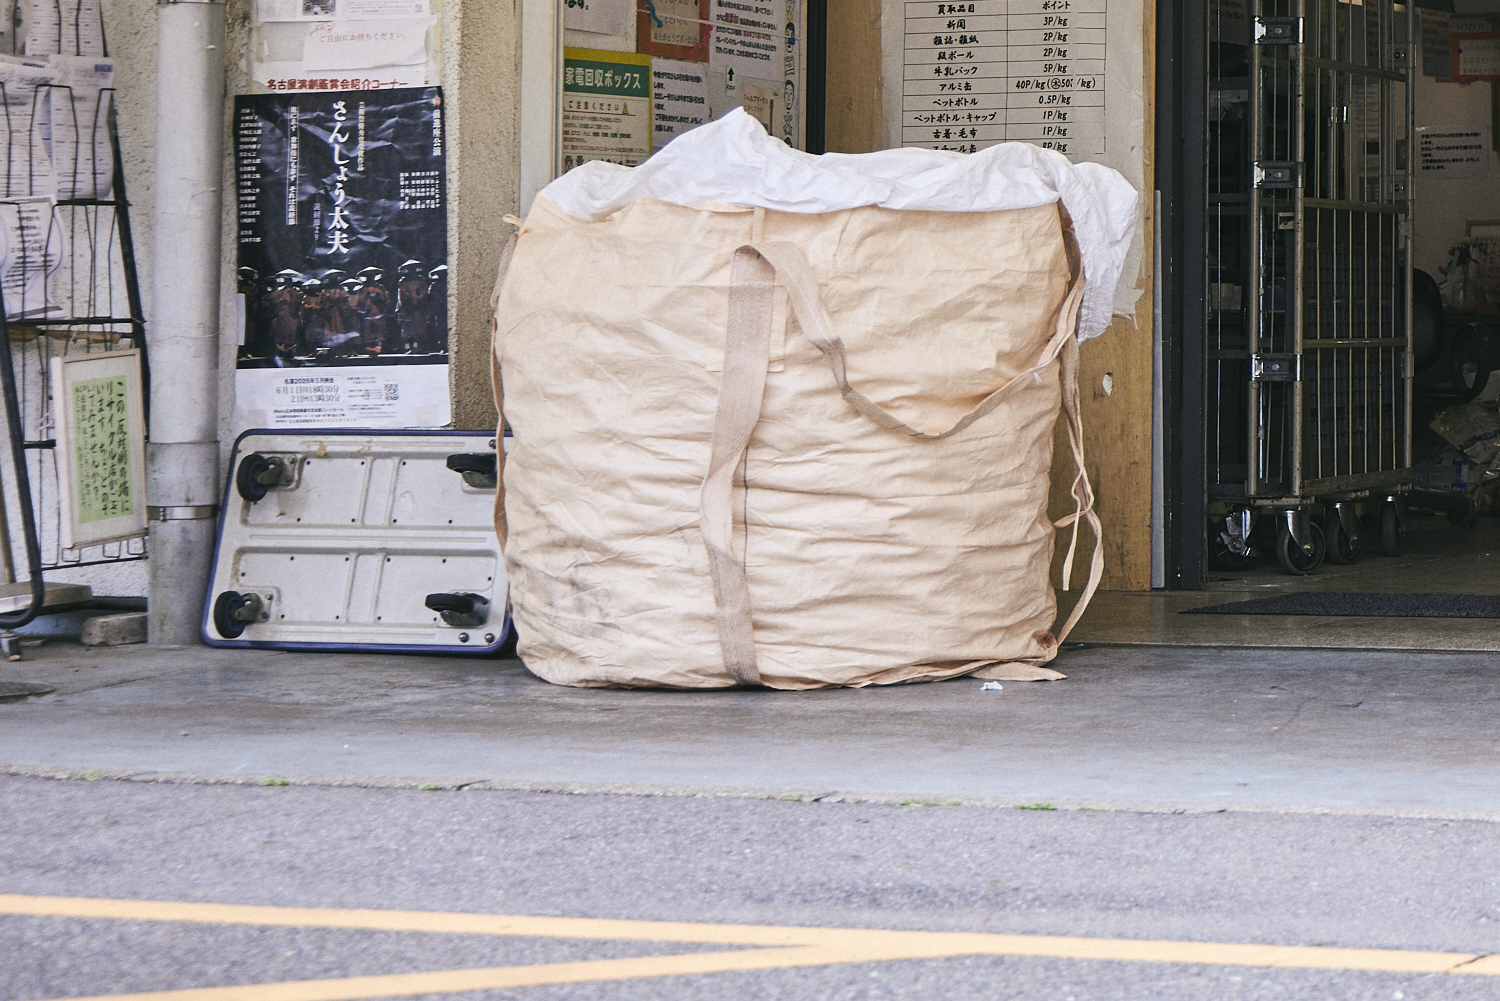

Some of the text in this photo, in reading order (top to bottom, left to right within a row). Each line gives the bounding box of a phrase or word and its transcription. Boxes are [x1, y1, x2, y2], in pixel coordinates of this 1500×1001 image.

[937, 3, 976, 15] 買取品目
[1042, 0, 1071, 11] ポイント
[946, 18, 966, 30] 新聞
[1043, 16, 1068, 27] 3P/kg
[1043, 32, 1068, 43] 2P/kg
[937, 50, 974, 61] 段ボール
[1043, 47, 1068, 59] 2P/kg
[934, 66, 978, 76] 牛乳パック
[1043, 63, 1068, 74] 5P/kg
[565, 67, 641, 89] 家電回収ボックス
[939, 82, 972, 92] アルミ缶
[932, 97, 978, 108] ペットボトル
[1038, 94, 1072, 106] 0.5P/kg
[913, 112, 997, 123] ペットボトル・キャップ
[1042, 110, 1068, 122] 1P/kg
[932, 127, 978, 139] 古着・毛布
[1042, 126, 1068, 137] 1P/kg
[327, 100, 350, 255] さんしょう太夫
